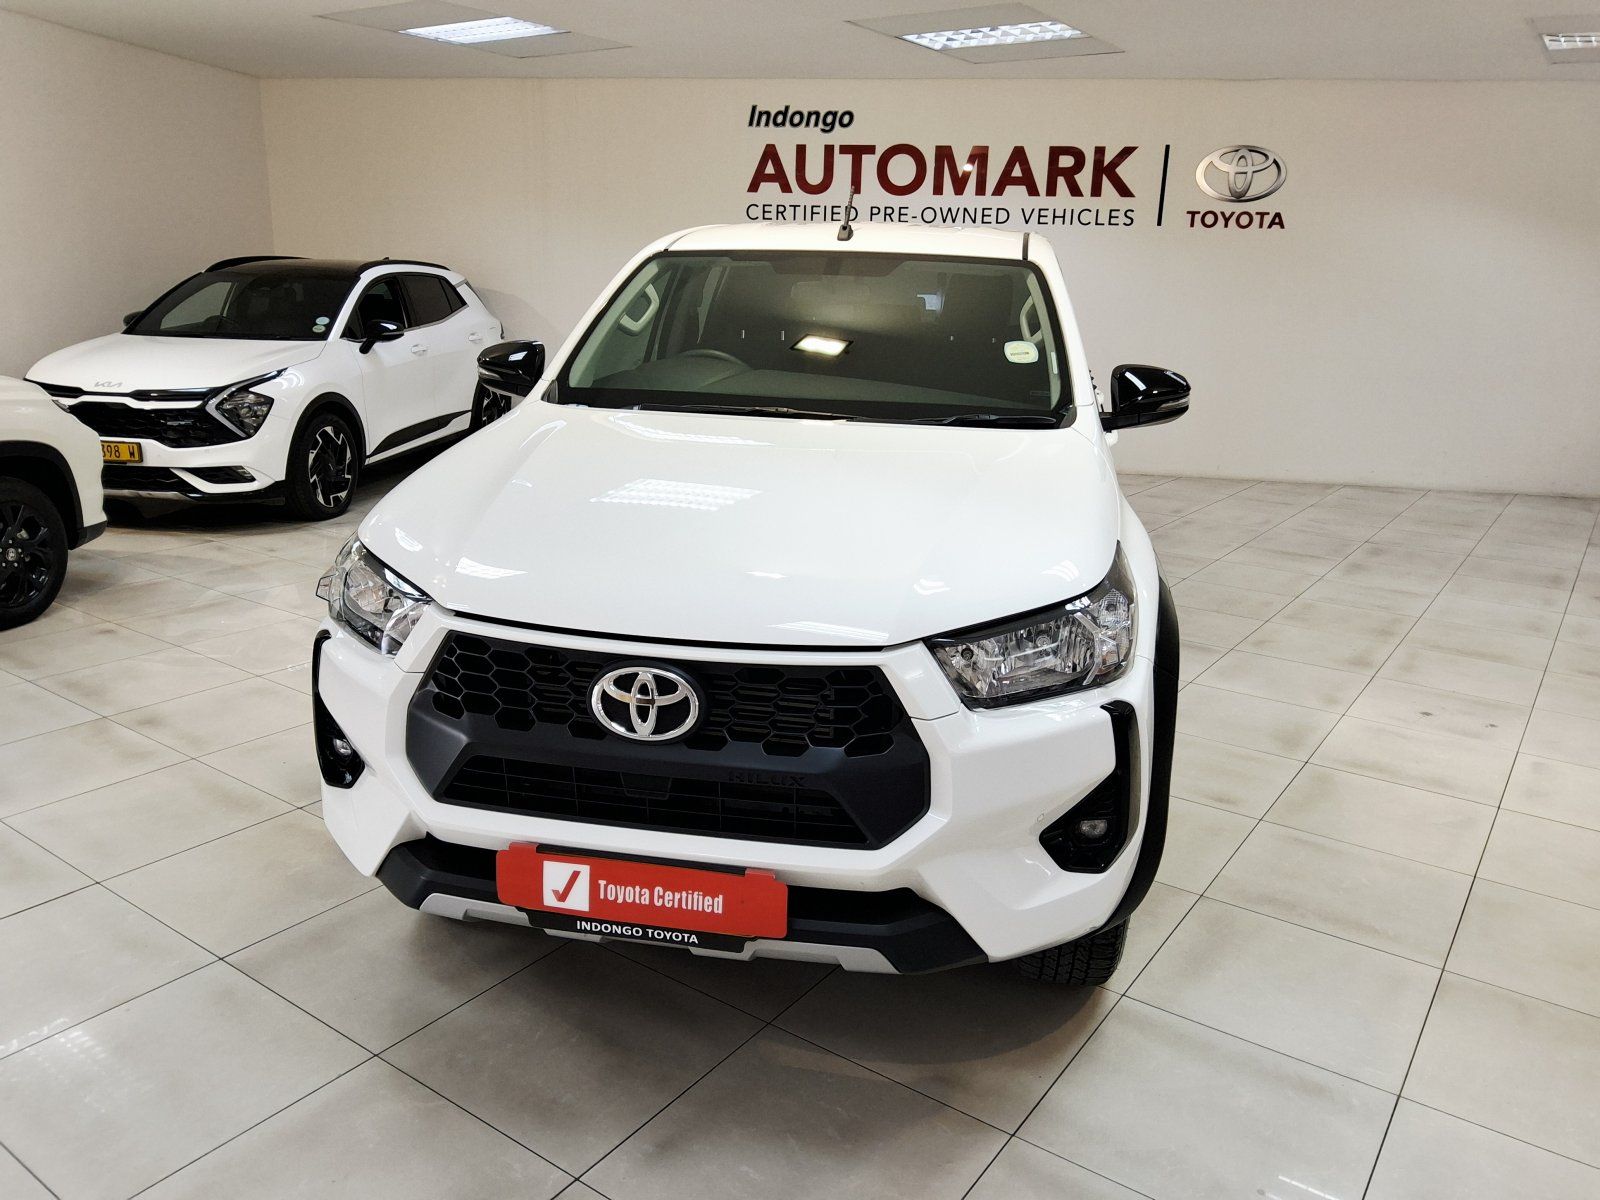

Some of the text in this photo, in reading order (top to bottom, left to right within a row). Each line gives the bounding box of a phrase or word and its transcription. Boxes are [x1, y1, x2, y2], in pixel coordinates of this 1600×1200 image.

[748, 105, 854, 133] Indongo
[747, 144, 1138, 197] AUTOMARK
[746, 203, 1135, 227] CERTIFIED PRE-OWNED VEHICLES
[1186, 210, 1286, 230] TOYOTA
[128, 444, 135, 459] W
[598, 879, 723, 914] Toyota Certified
[576, 920, 698, 944] INDONGO TOYOTA
